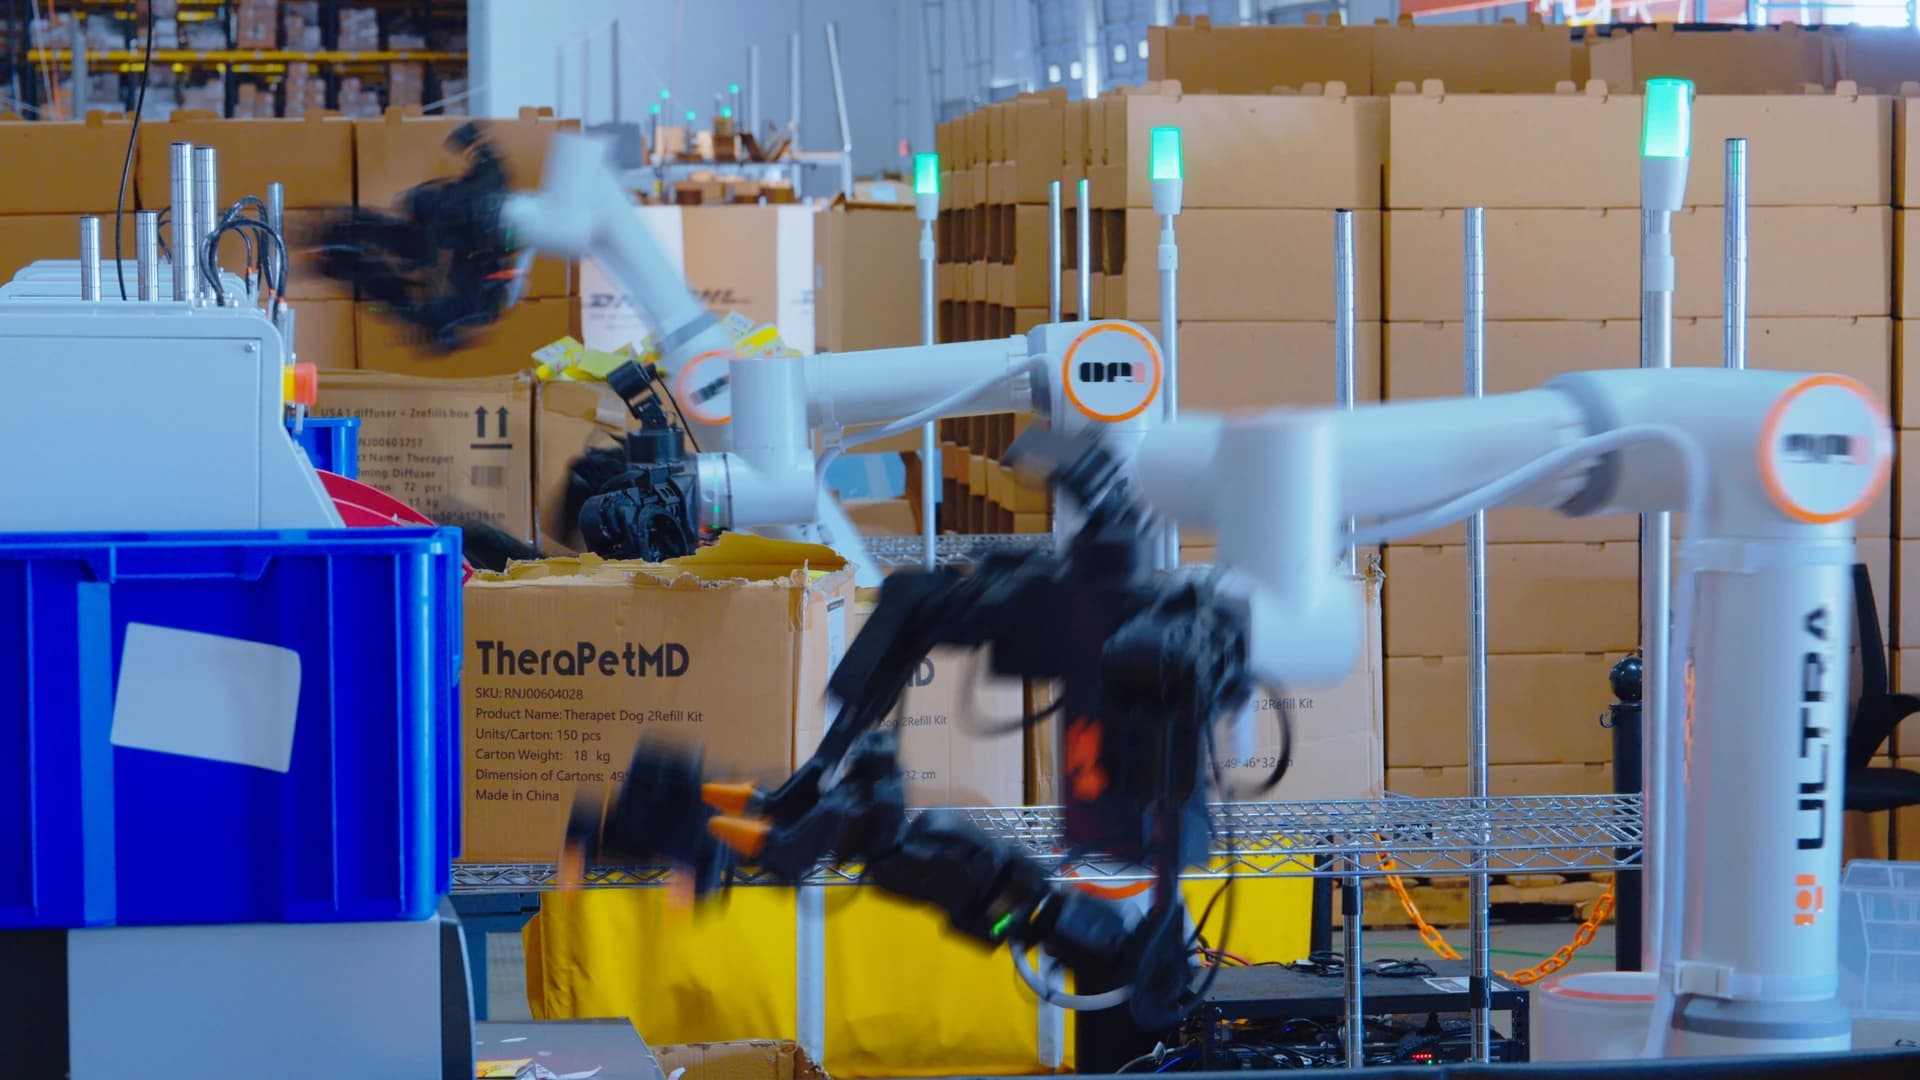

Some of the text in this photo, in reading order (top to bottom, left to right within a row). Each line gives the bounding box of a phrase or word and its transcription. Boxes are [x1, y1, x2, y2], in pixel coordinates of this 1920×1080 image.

[353, 407, 397, 418] diffuser
[358, 437, 422, 448] NJ00603757
[392, 467, 436, 479] Diffuser
[475, 640, 690, 678] TheraPetMD
[475, 687, 584, 700] SKU: RNJ00604028
[1261, 698, 1296, 710] 2Refill
[1298, 698, 1314, 709] Kit
[475, 707, 704, 724] Product Name: Therapet Dog 2Refill Kit
[902, 715, 932, 727] 2Refill
[934, 714, 947, 726] Kit
[1796, 607, 1828, 850] ULTRA
[475, 727, 602, 744] Units/Carton: 150 pcs
[475, 748, 611, 764] Carton Weight: 18 kg
[475, 768, 538, 781] Dimension
[540, 769, 554, 781] of
[556, 769, 605, 782] Cartons:
[921, 770, 937, 780] cm
[475, 788, 560, 802] Made in China
